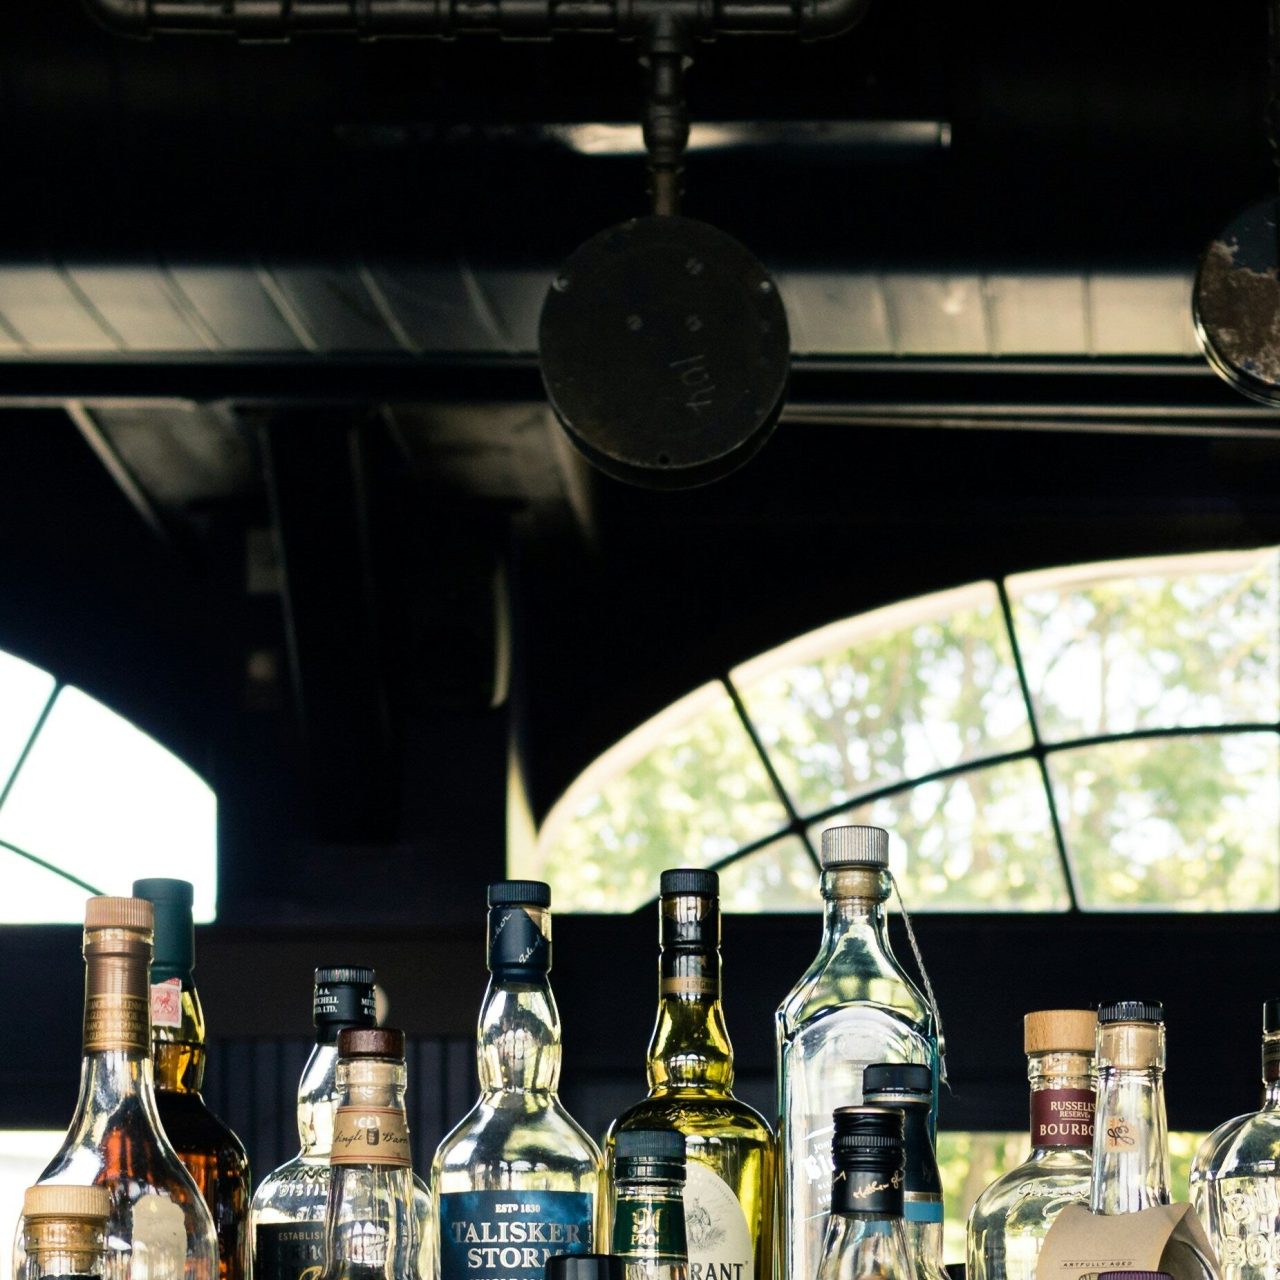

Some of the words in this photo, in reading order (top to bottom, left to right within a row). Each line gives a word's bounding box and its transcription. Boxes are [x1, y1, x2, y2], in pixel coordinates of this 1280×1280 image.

[1060, 1111, 1091, 1119] RESERVE
[1039, 1124, 1096, 1137] BOURBO
[521, 1204, 541, 1214] 1830
[452, 1222, 582, 1244] TALISKER
